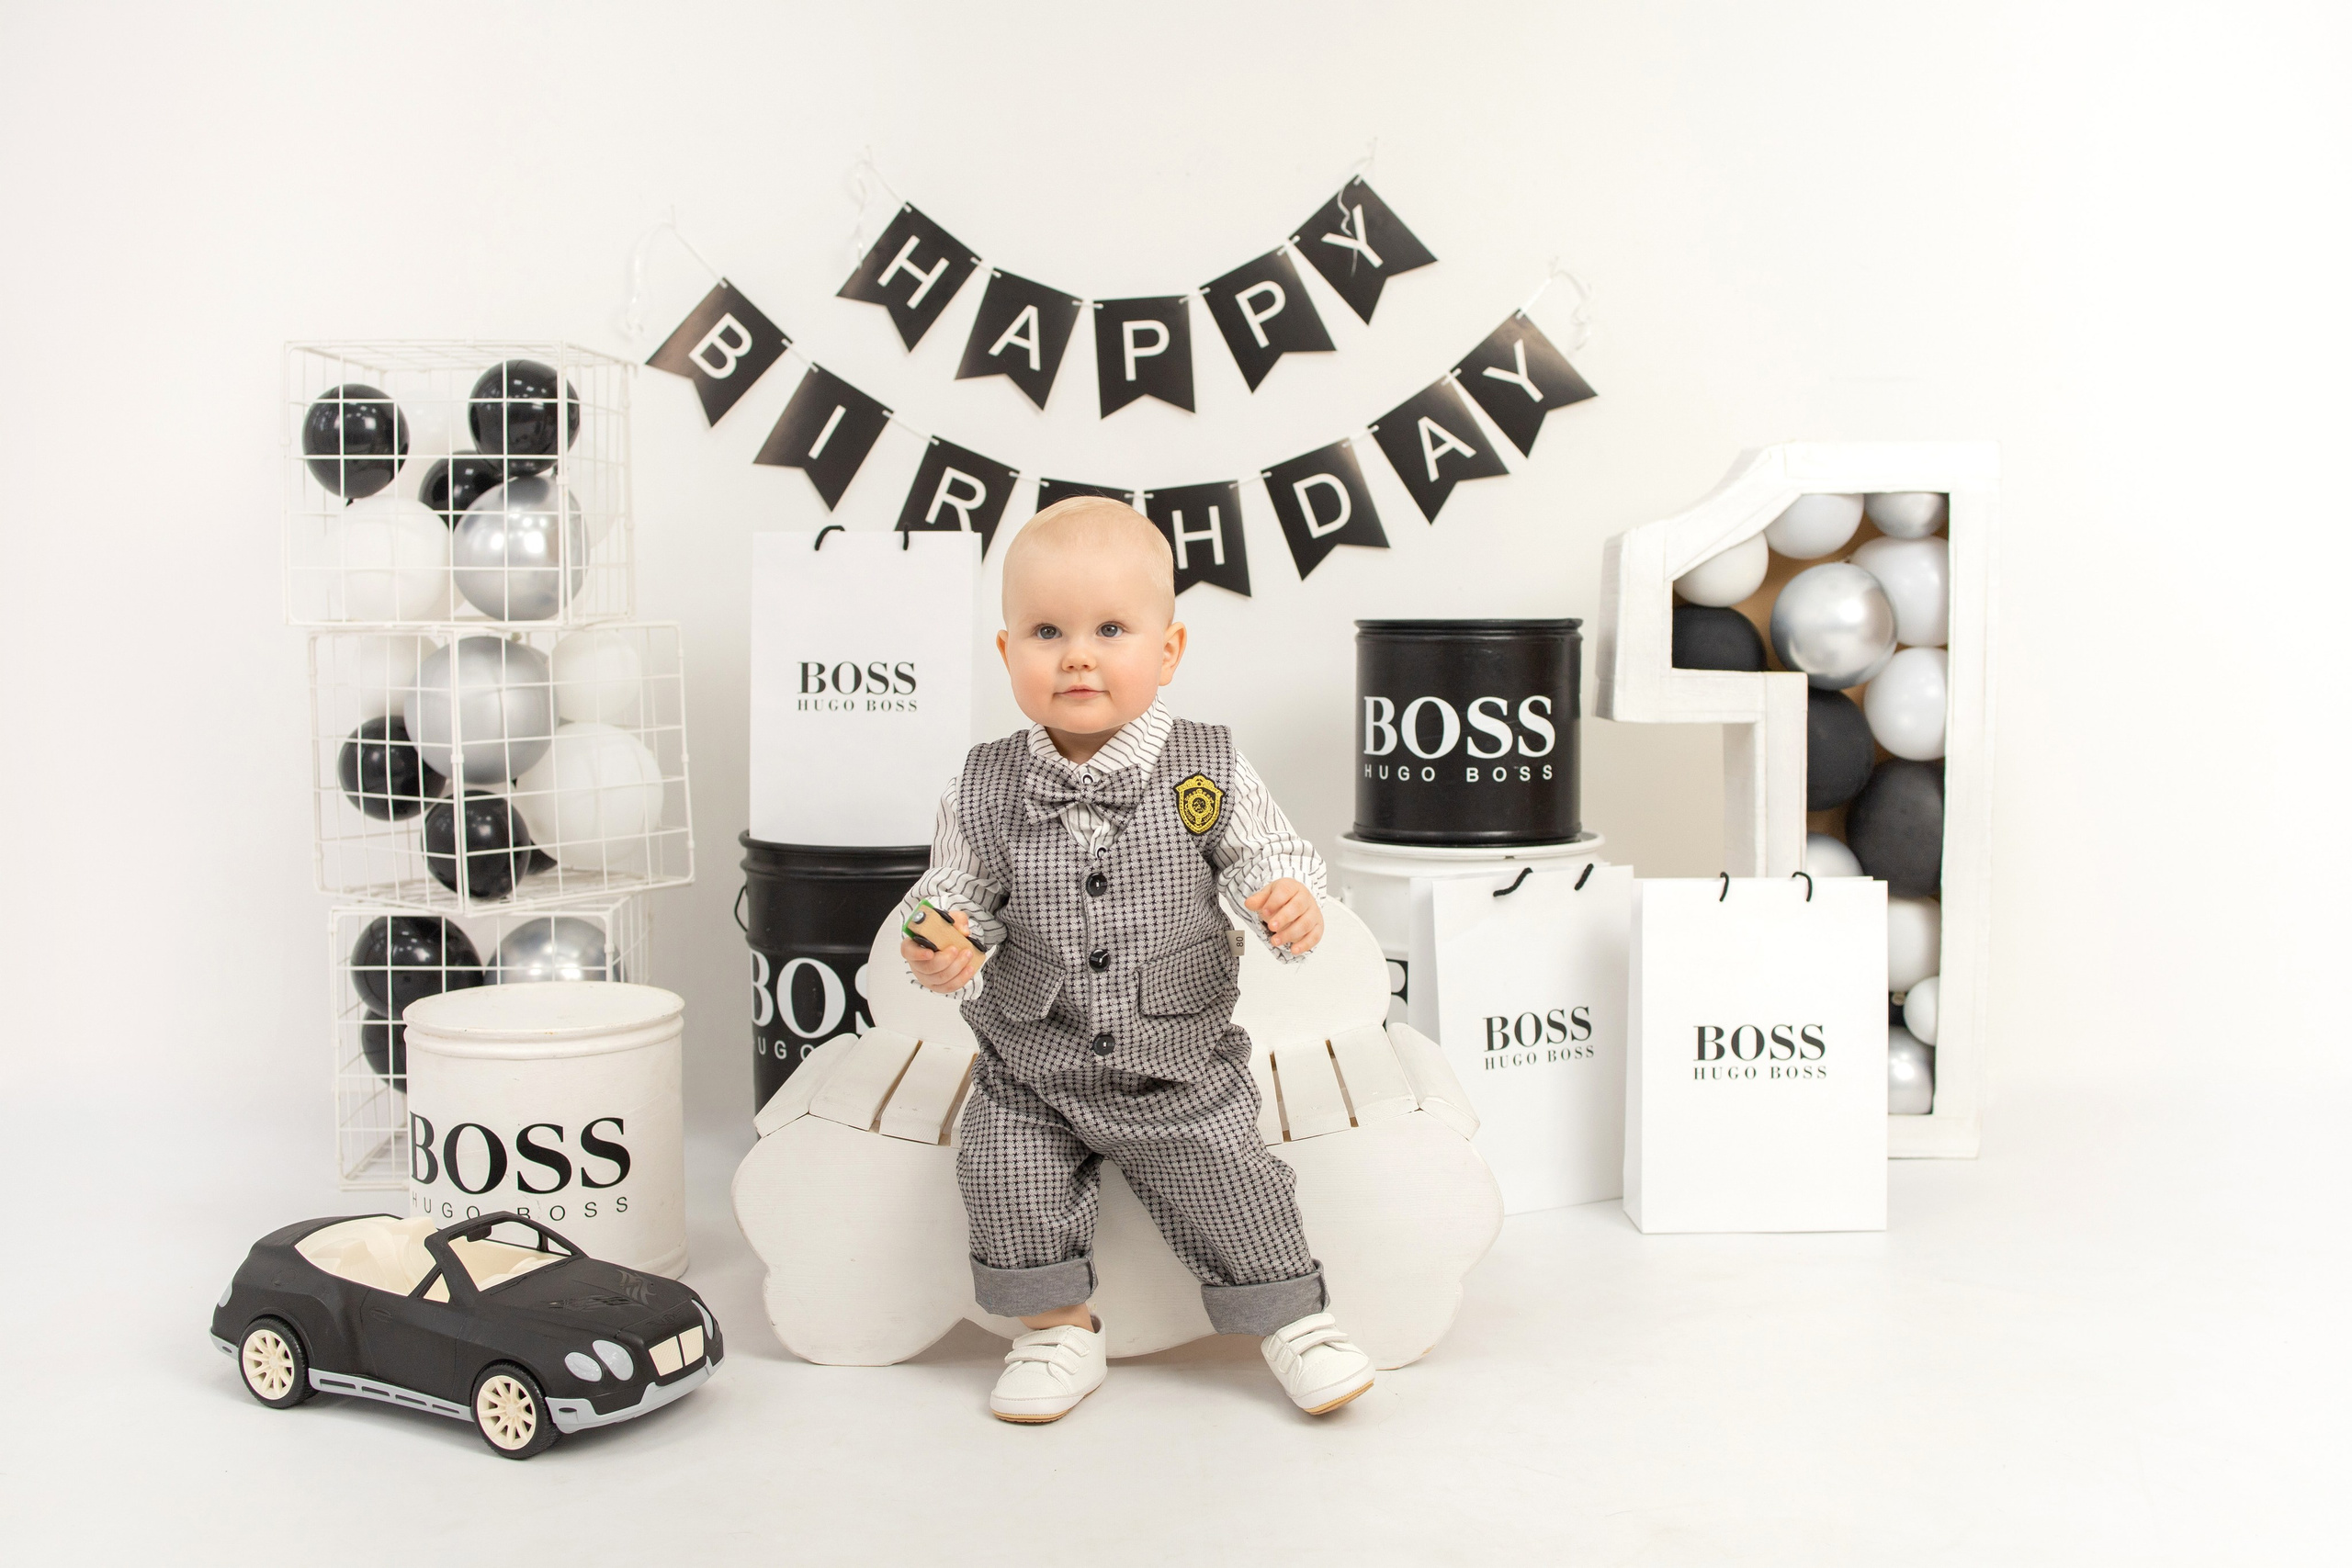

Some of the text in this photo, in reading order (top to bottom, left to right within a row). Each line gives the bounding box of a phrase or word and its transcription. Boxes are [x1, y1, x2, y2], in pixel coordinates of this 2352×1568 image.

[877, 204, 1383, 381] HAPPY
[688, 312, 1544, 570] BIRHDAY
[797, 661, 917, 695] BOSS
[797, 699, 917, 713] HUGO BOSS
[1363, 695, 1555, 760] BOSS
[1364, 763, 1553, 783] HUGO BOSS
[1482, 1006, 1592, 1053] BOSS
[1693, 1024, 1826, 1061] BOSS
[1485, 1044, 1595, 1071] HUGO BOSS
[1693, 1066, 1827, 1080] HUGO BOSS
[410, 1111, 631, 1195] BOSS
[517, 1197, 628, 1221] BOSS
